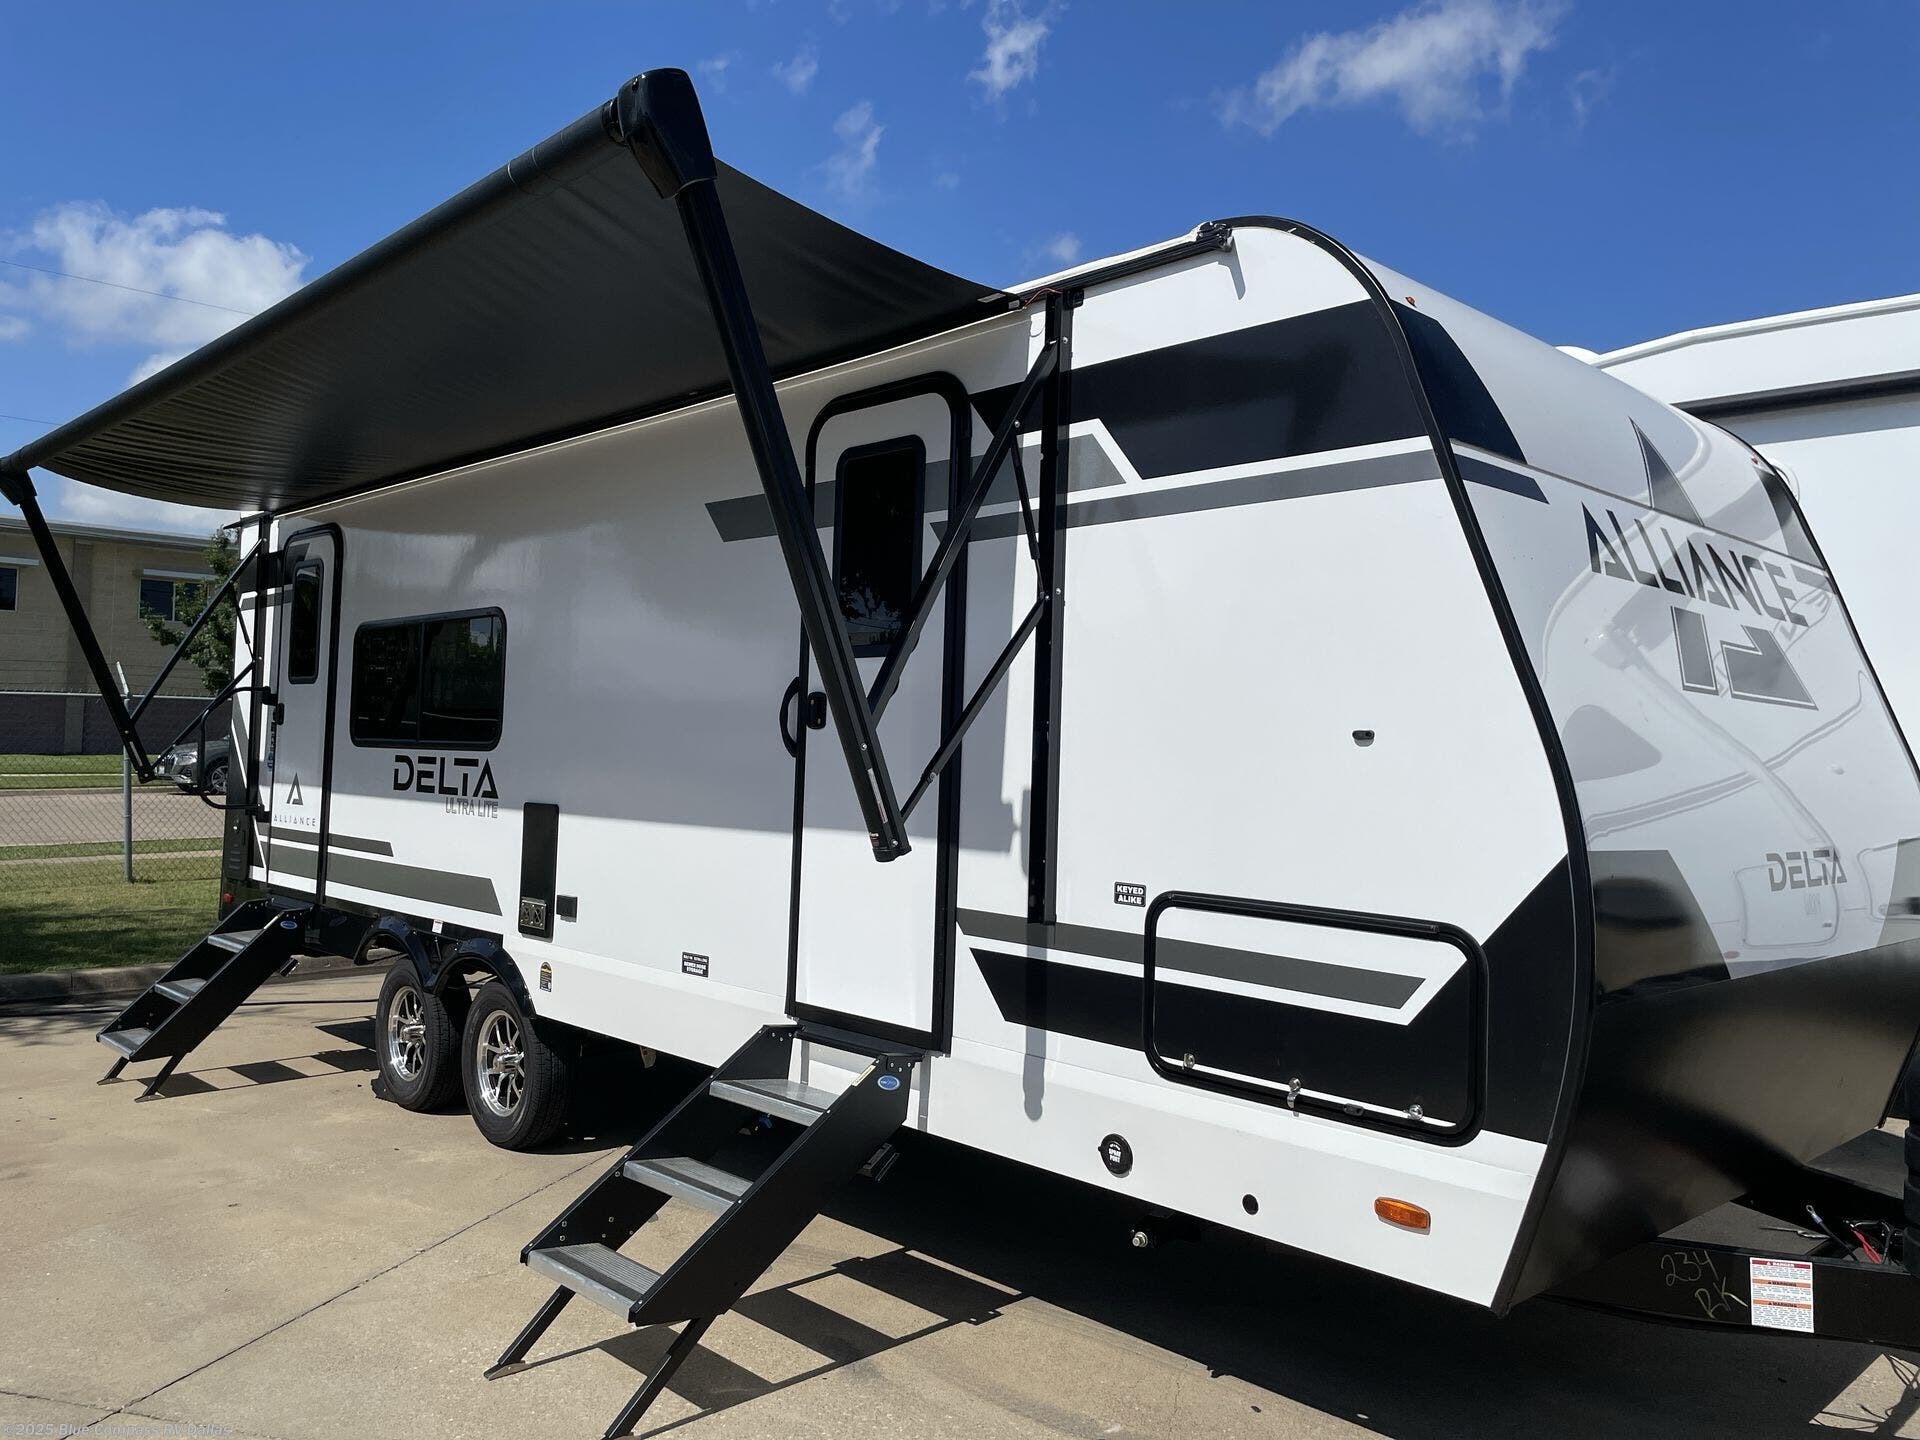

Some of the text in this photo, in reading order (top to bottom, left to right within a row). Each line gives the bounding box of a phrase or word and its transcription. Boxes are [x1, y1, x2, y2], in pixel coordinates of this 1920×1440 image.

[1581, 500, 1808, 627] ALLIANCE
[393, 754, 499, 799] DELTA
[273, 813, 316, 827] ALLIANCE
[445, 796, 499, 818] ULTRA LITE
[1766, 848, 1848, 892] DELTA
[1116, 885, 1144, 895] KEYED
[1117, 895, 1142, 905] ALIKE
[1660, 1250, 1720, 1287] 234
